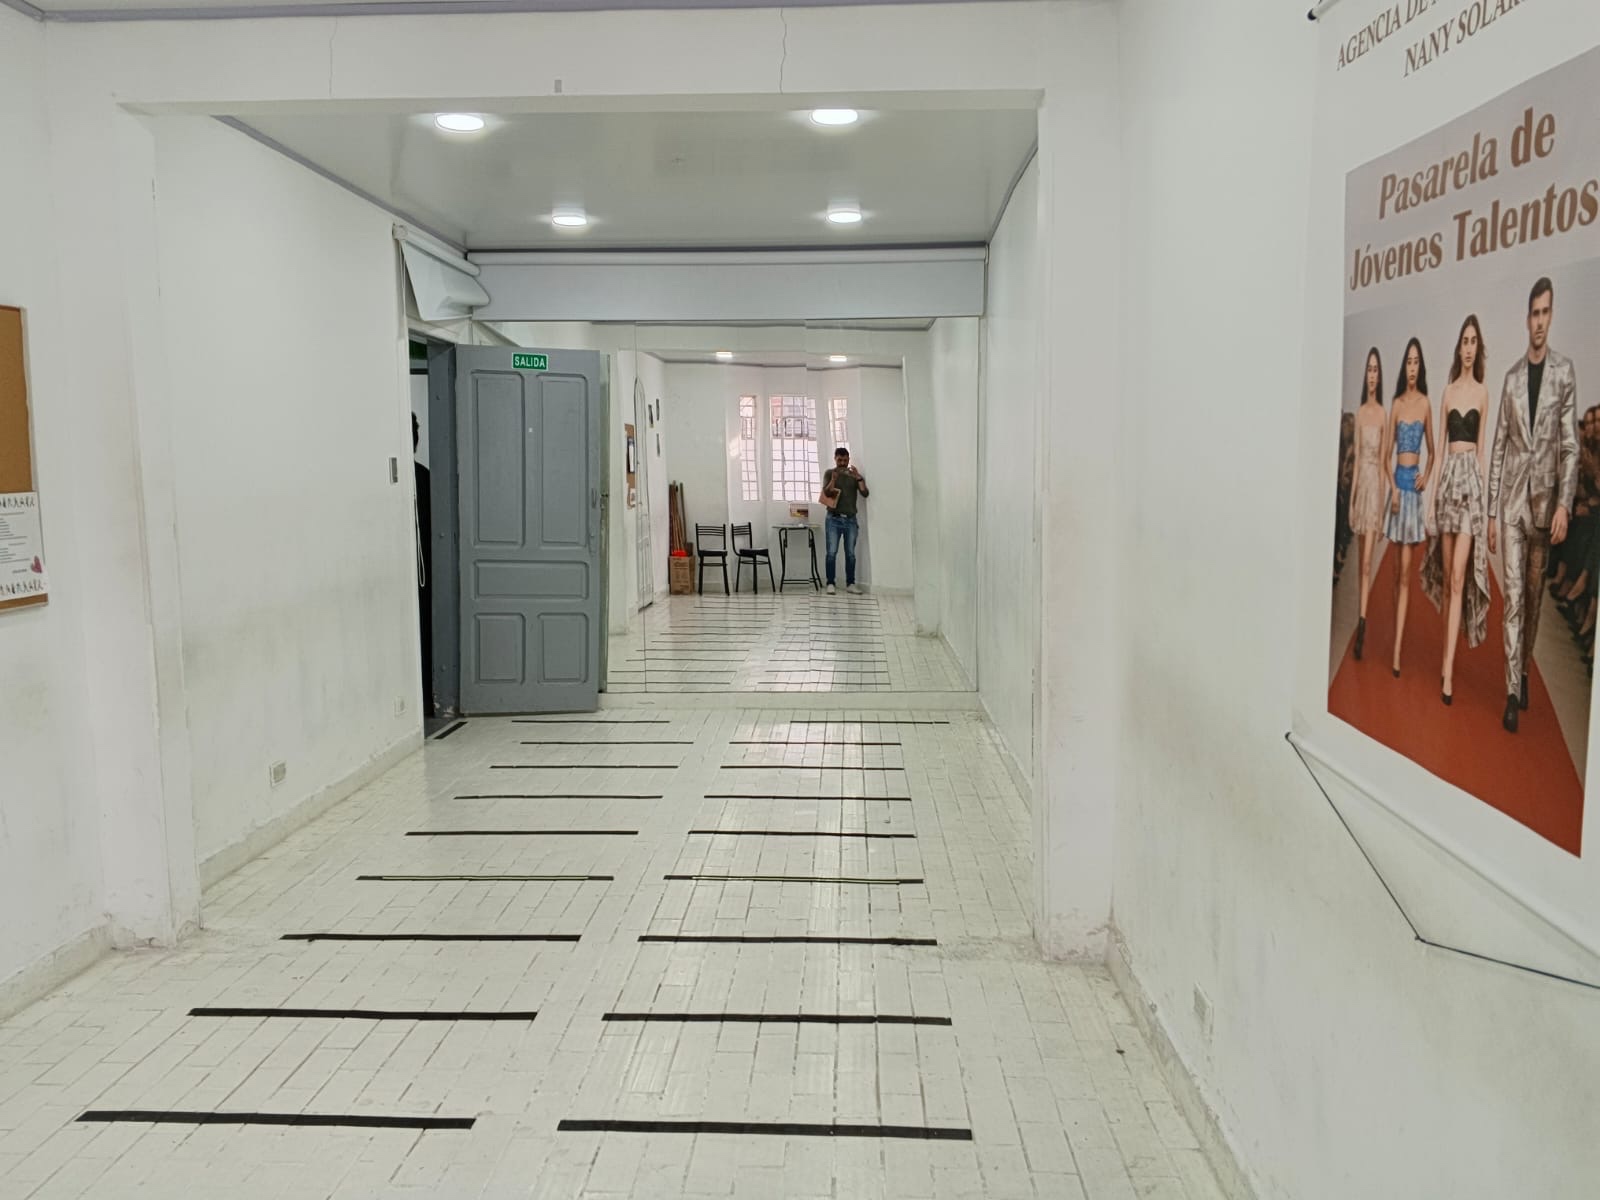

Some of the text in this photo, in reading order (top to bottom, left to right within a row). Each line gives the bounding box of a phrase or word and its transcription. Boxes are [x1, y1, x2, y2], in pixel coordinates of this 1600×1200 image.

[1337, 3, 1402, 71] AGENCIA
[1403, 17, 1455, 77] NANY
[1379, 106, 1556, 220] Pasarela de
[1349, 179, 1599, 291] Jóvenes Talentos
[514, 356, 546, 368] SALIDA
